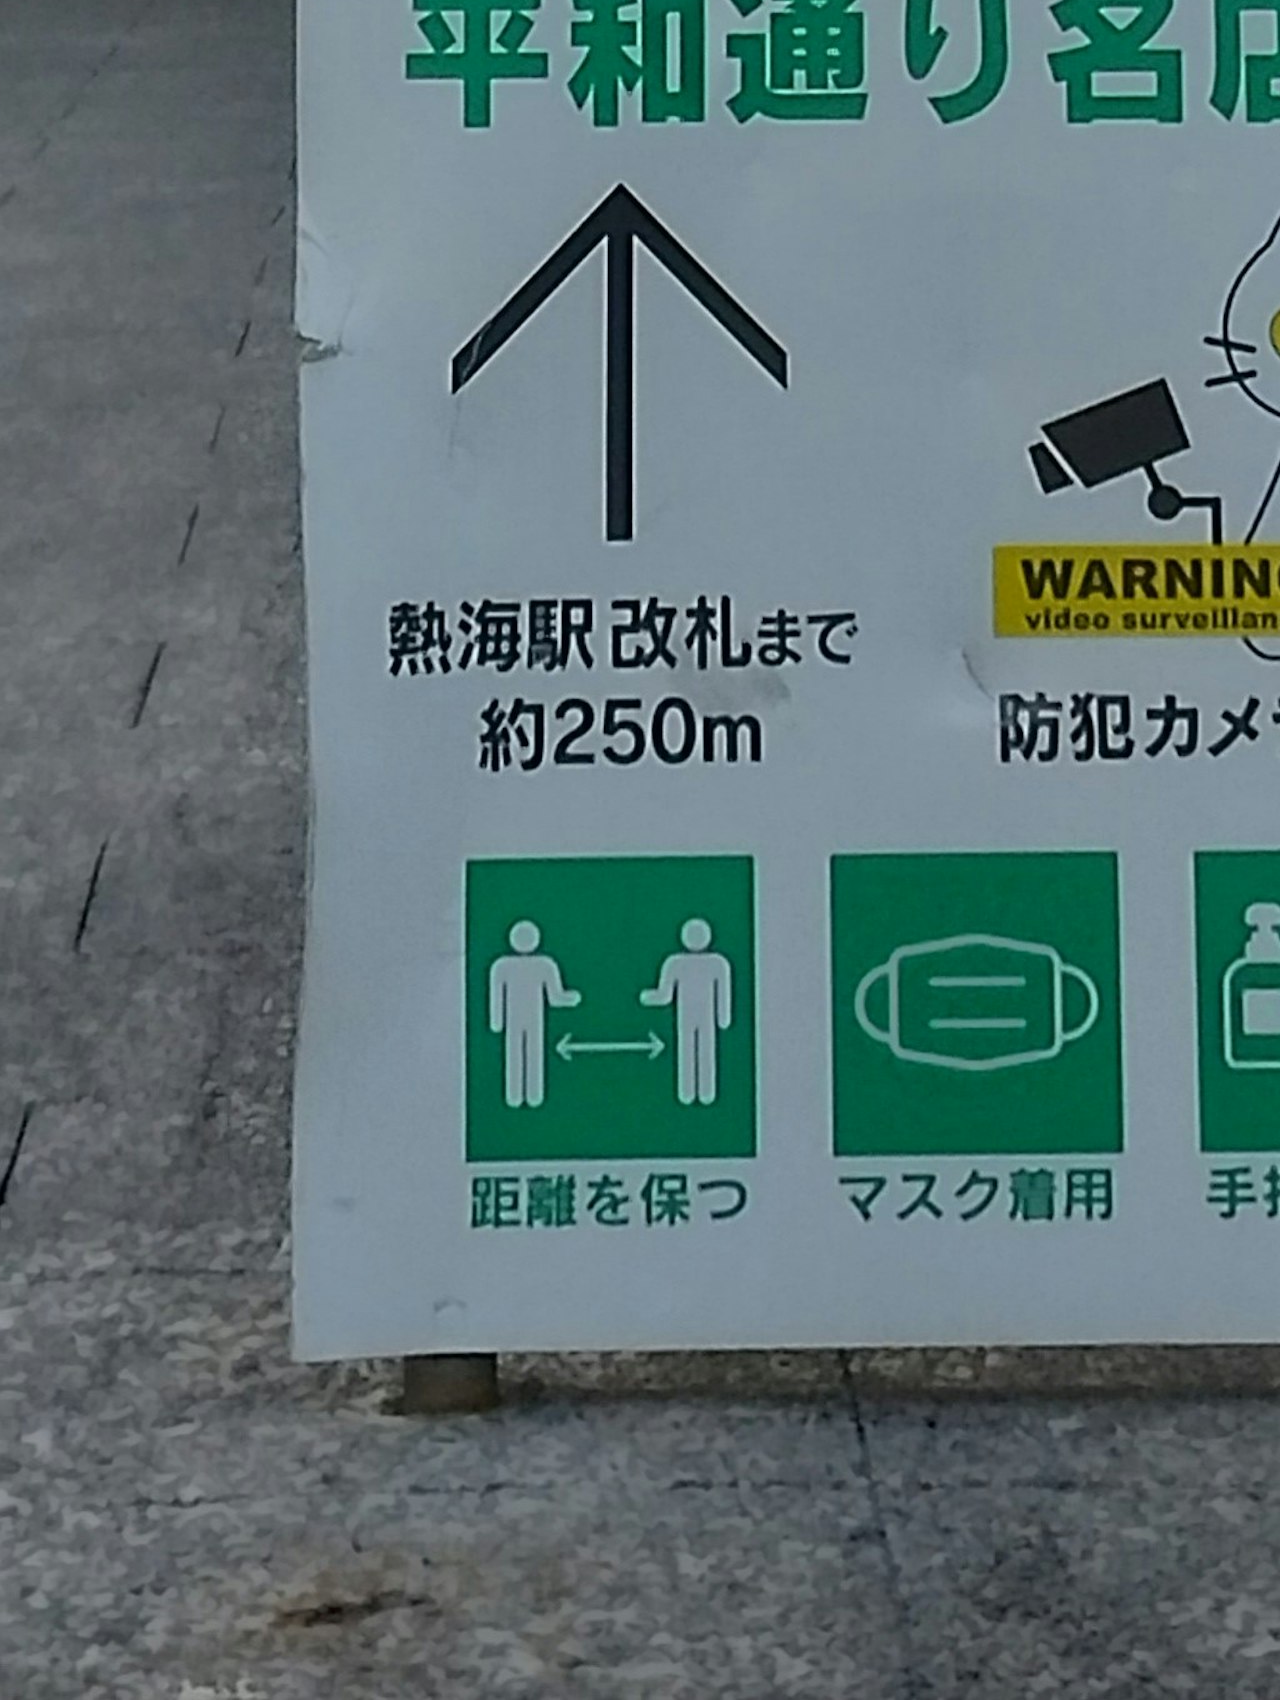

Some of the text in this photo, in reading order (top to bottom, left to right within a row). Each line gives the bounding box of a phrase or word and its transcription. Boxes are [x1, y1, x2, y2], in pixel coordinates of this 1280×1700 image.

[1025, 608, 1109, 631] video
[479, 696, 762, 772] 約250m
[470, 1171, 749, 1230] 距離を保つ
[838, 1166, 1115, 1223] マスク着用
